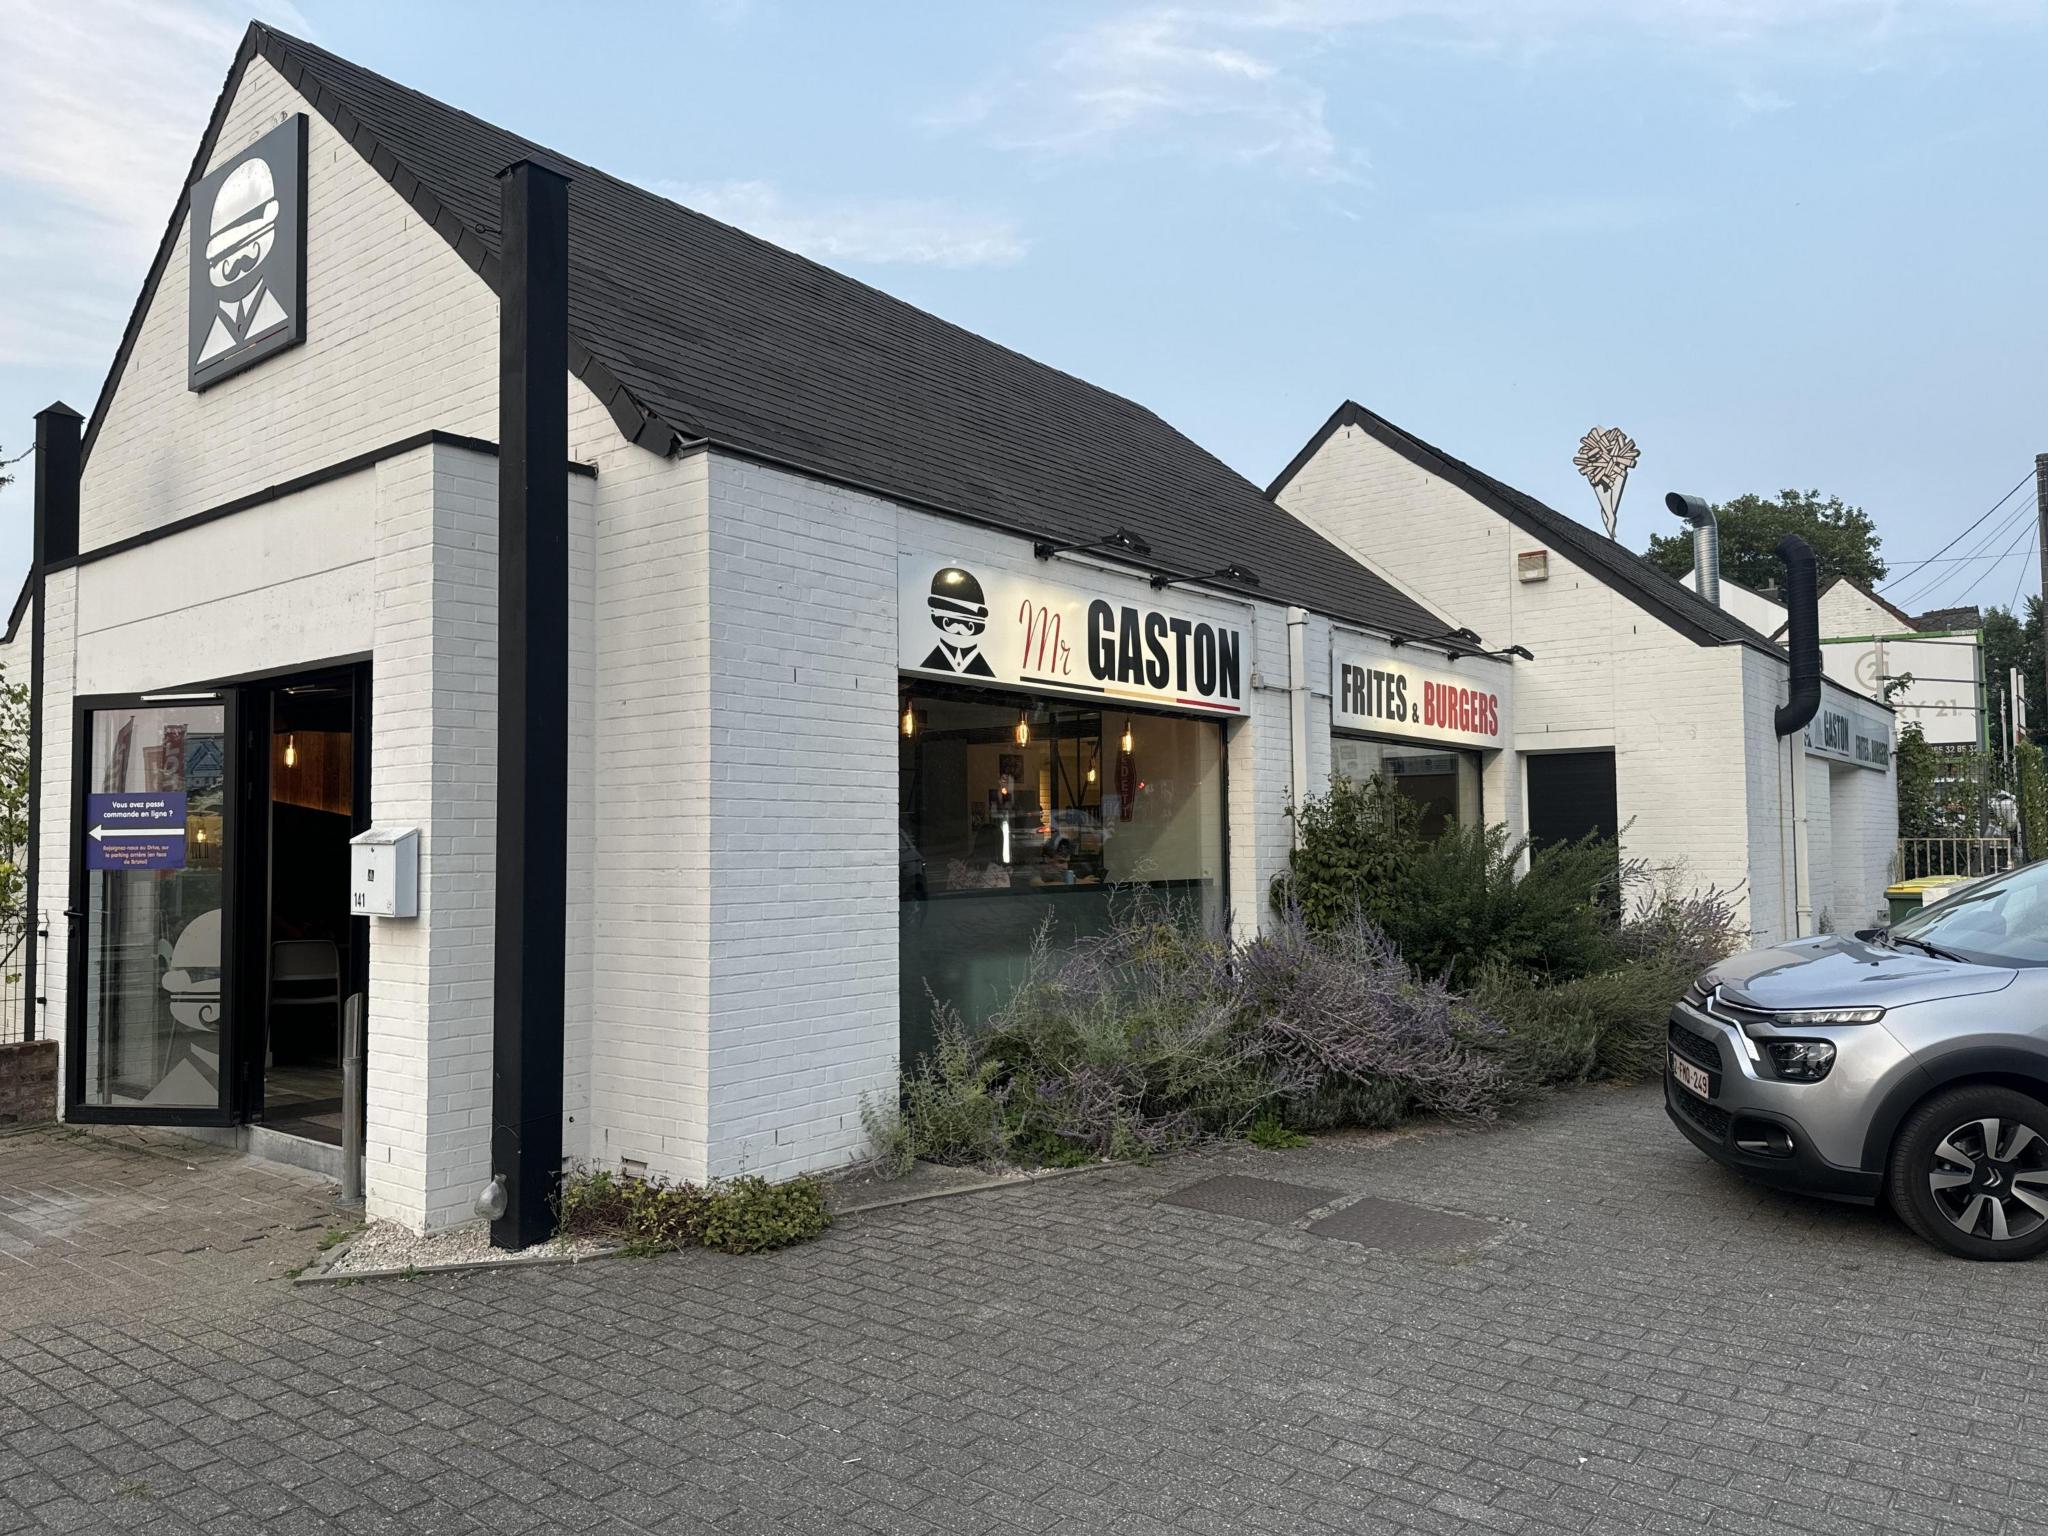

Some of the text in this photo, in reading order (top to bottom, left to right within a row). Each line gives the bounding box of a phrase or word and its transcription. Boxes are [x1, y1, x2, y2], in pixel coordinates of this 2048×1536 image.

[1019, 599, 1240, 700] Mr GASTON
[1341, 663, 1499, 737] FRITES & BURGERS
[1935, 699, 1957, 717] 21
[1823, 710, 1849, 752] GASTON
[1945, 745, 1955, 753] 32
[145, 800, 165, 809] passé
[103, 810, 139, 818] commande
[151, 810, 167, 819] ligne
[169, 809, 174, 817] ?
[354, 892, 365, 908] 141
